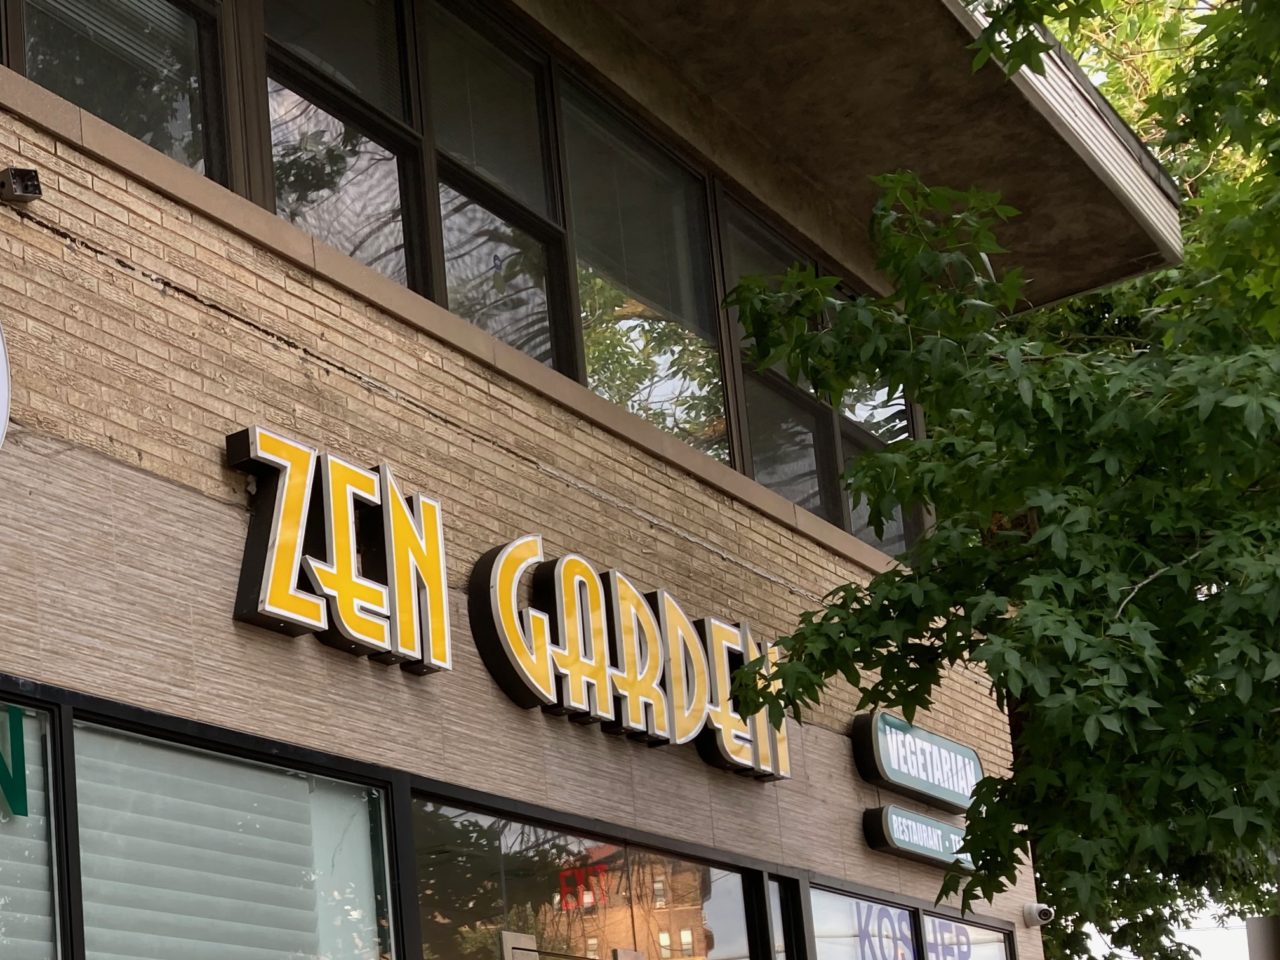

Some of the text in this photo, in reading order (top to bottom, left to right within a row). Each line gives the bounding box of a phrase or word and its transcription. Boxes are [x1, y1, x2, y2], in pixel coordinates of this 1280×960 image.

[248, 424, 792, 779] ZEN GARDEN
[885, 725, 977, 798] VEGETARIAN
[891, 814, 944, 852] RESTAURANT
